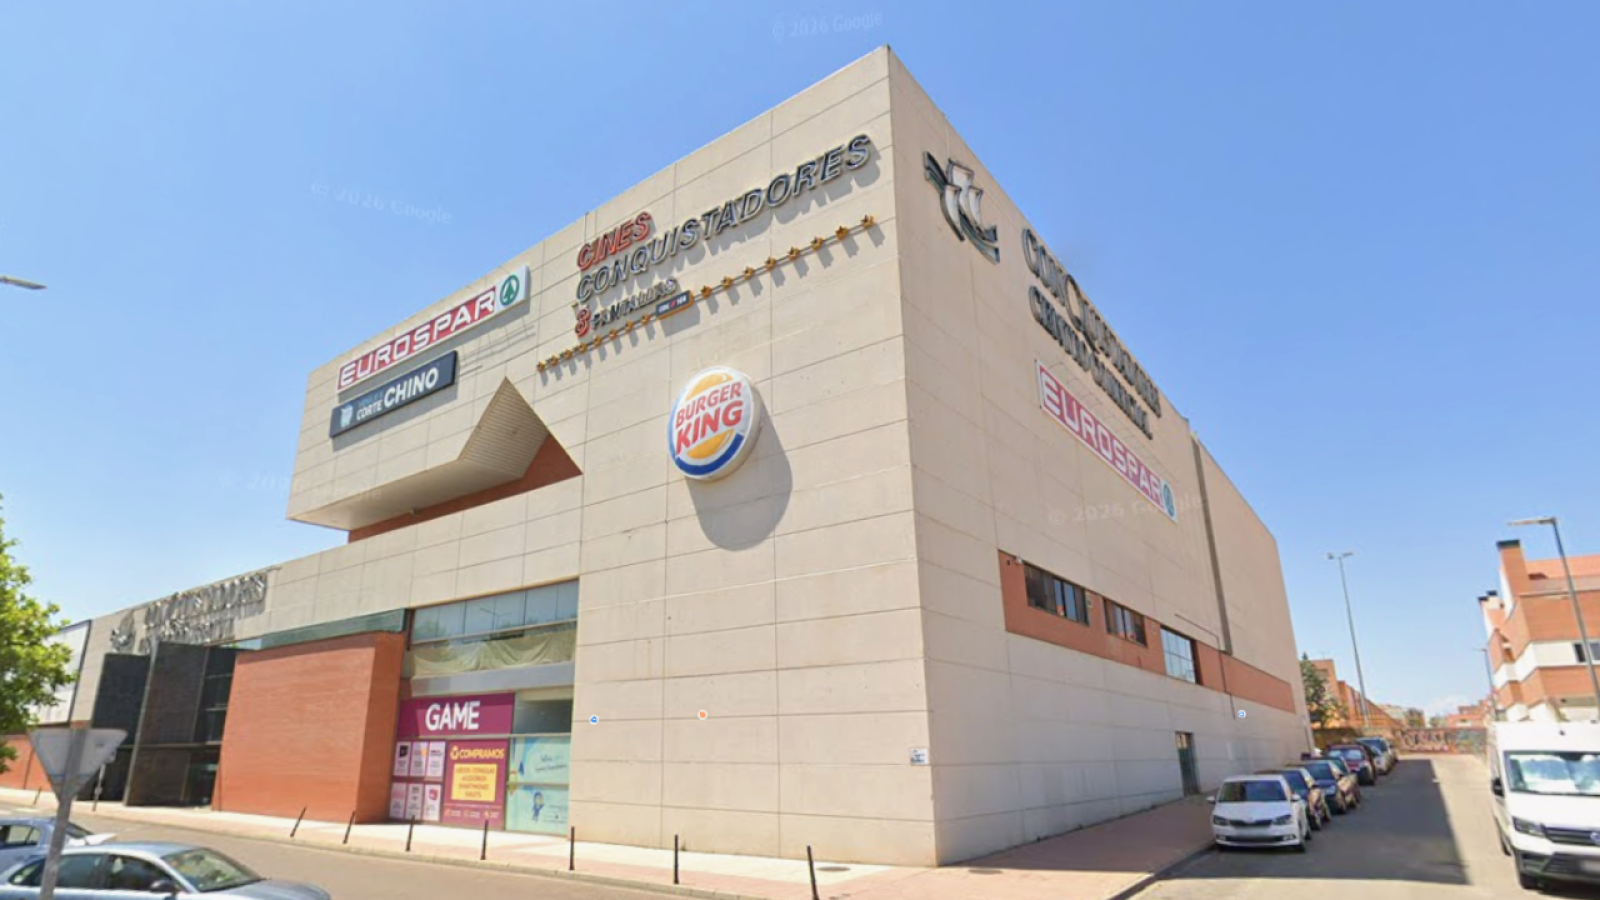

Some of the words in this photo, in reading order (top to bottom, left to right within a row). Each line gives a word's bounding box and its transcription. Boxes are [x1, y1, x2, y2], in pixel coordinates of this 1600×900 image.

[576, 133, 871, 302] CONQUISTADORES
[576, 211, 651, 270] CINES
[339, 289, 495, 386] EUROSPAR
[356, 399, 383, 420] CORTE
[384, 367, 439, 408] CHINO
[675, 382, 743, 429] BURGER
[676, 400, 744, 456] KING
[1041, 369, 1163, 506] EUROSPAR
[425, 700, 480, 731] GAME
